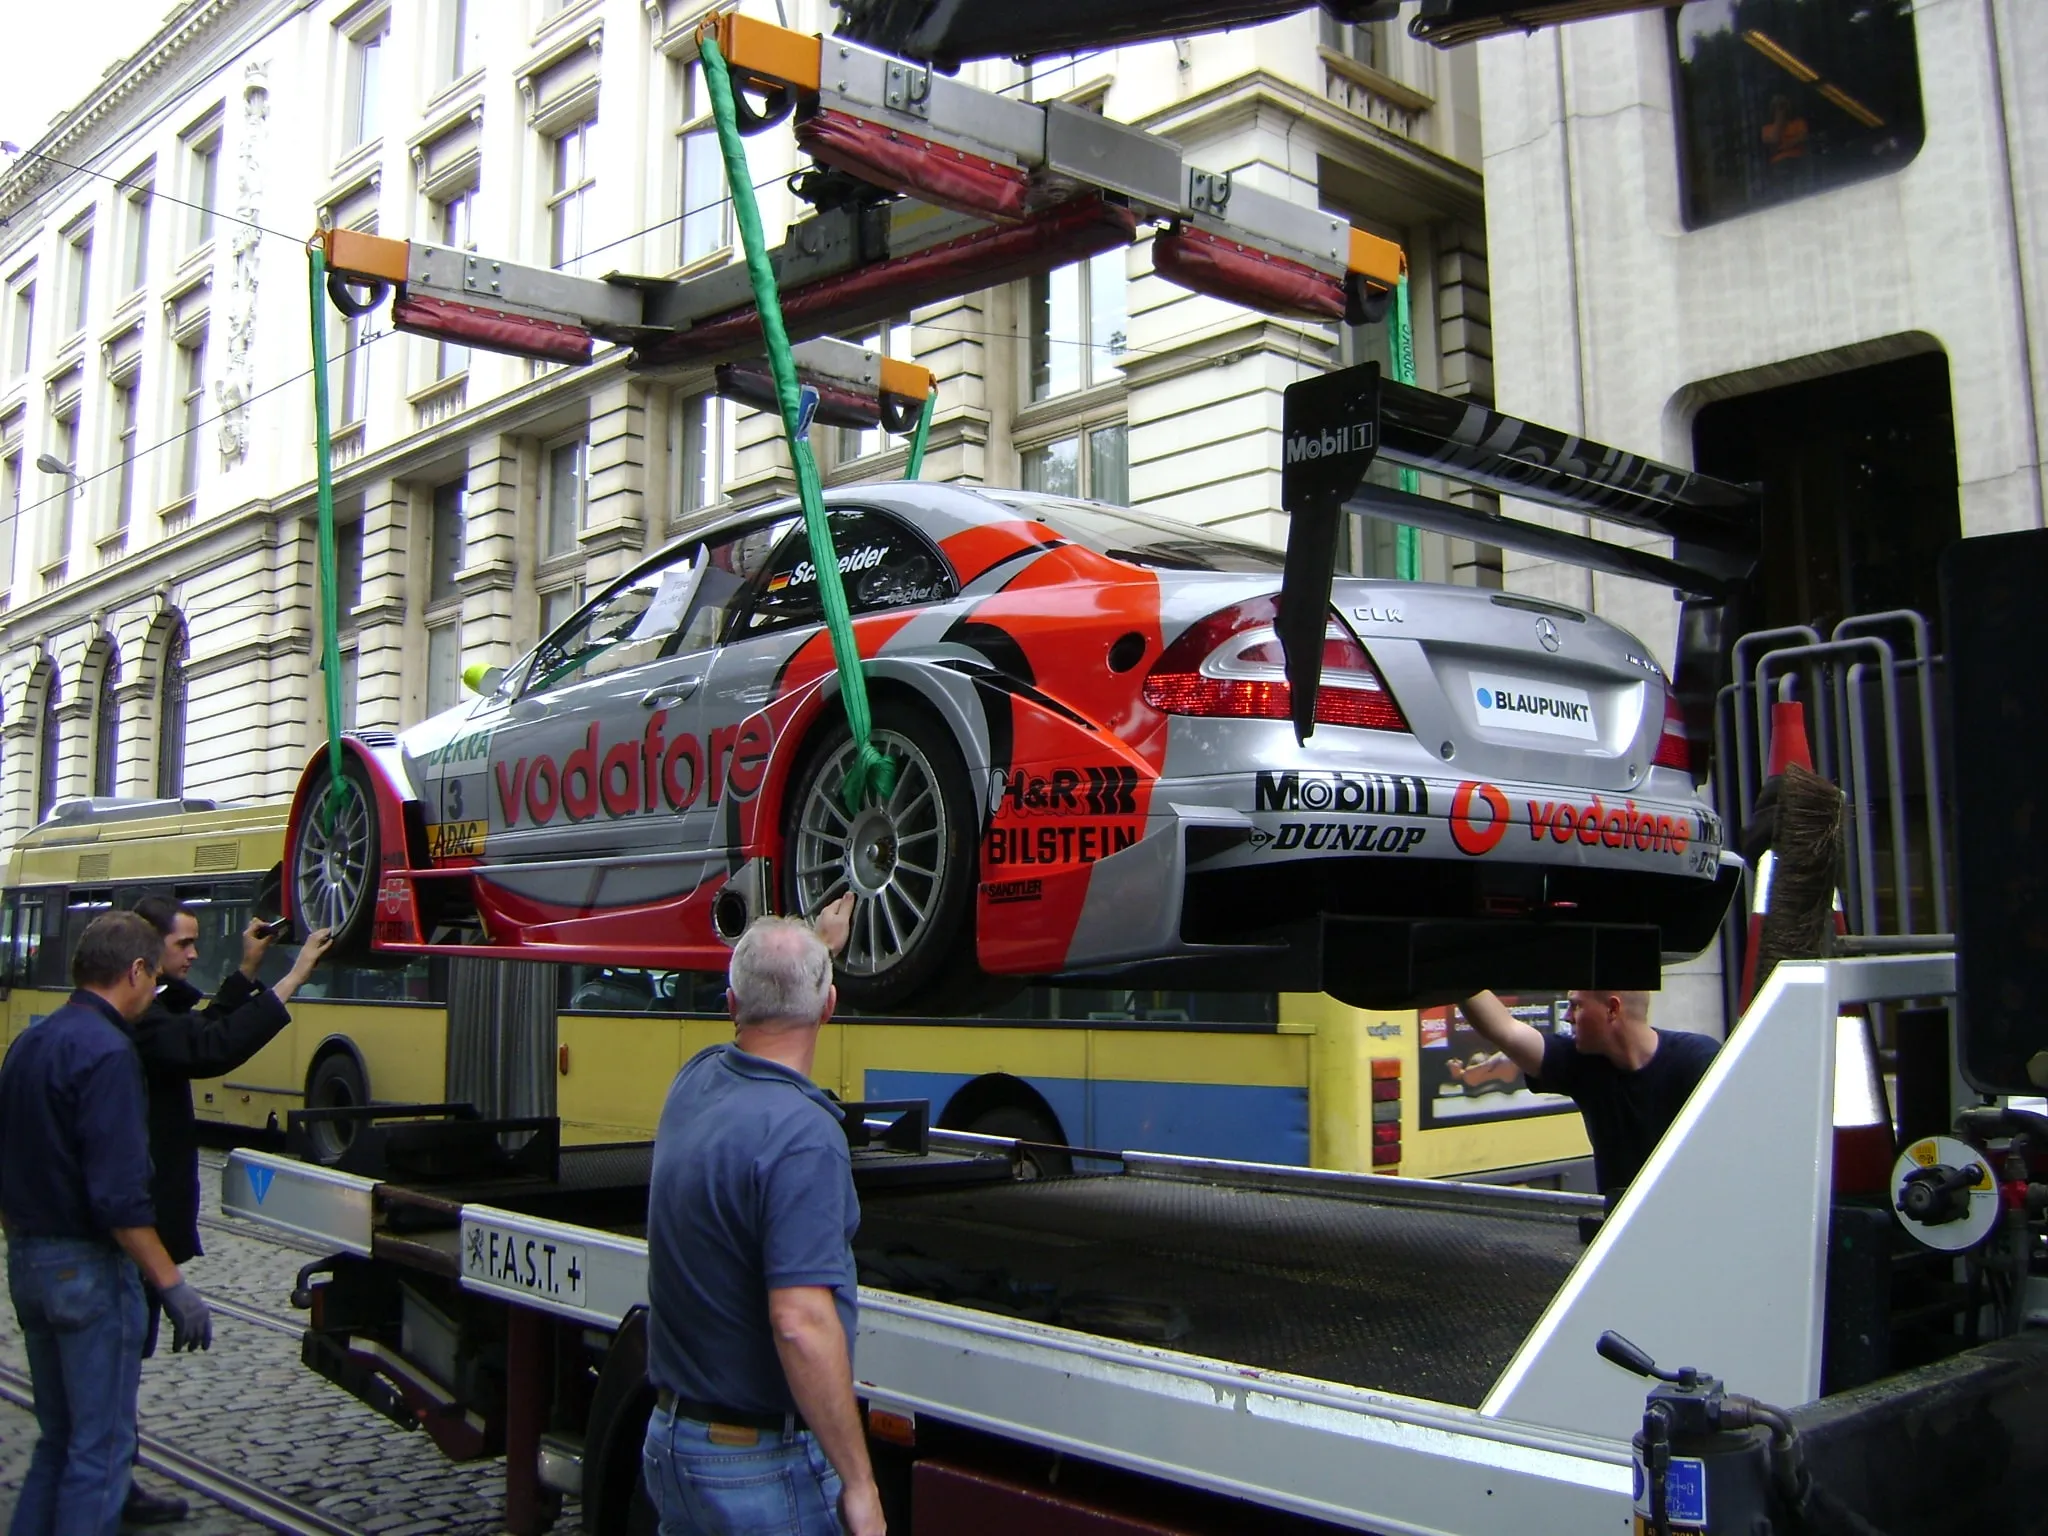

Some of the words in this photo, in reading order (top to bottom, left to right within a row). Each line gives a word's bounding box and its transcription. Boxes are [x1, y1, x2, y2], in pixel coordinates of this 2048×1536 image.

[1286, 427, 1349, 465] Mobil
[1424, 403, 1636, 506] Mobil
[791, 545, 890, 586] Sceider
[1353, 607, 1404, 624] CLK
[1494, 690, 1589, 723] BLAUPUNKT
[448, 779, 464, 820] 3
[989, 768, 1085, 819] H&R
[1255, 770, 1387, 812] Mobil
[432, 822, 478, 857] ADAC
[1271, 823, 1426, 853] DUNLOP
[1527, 794, 1691, 856] vodafone
[988, 826, 1136, 865] BILSTEIN
[988, 880, 1042, 897] SANDTLER
[490, 1231, 559, 1294] F.A.S.T.
